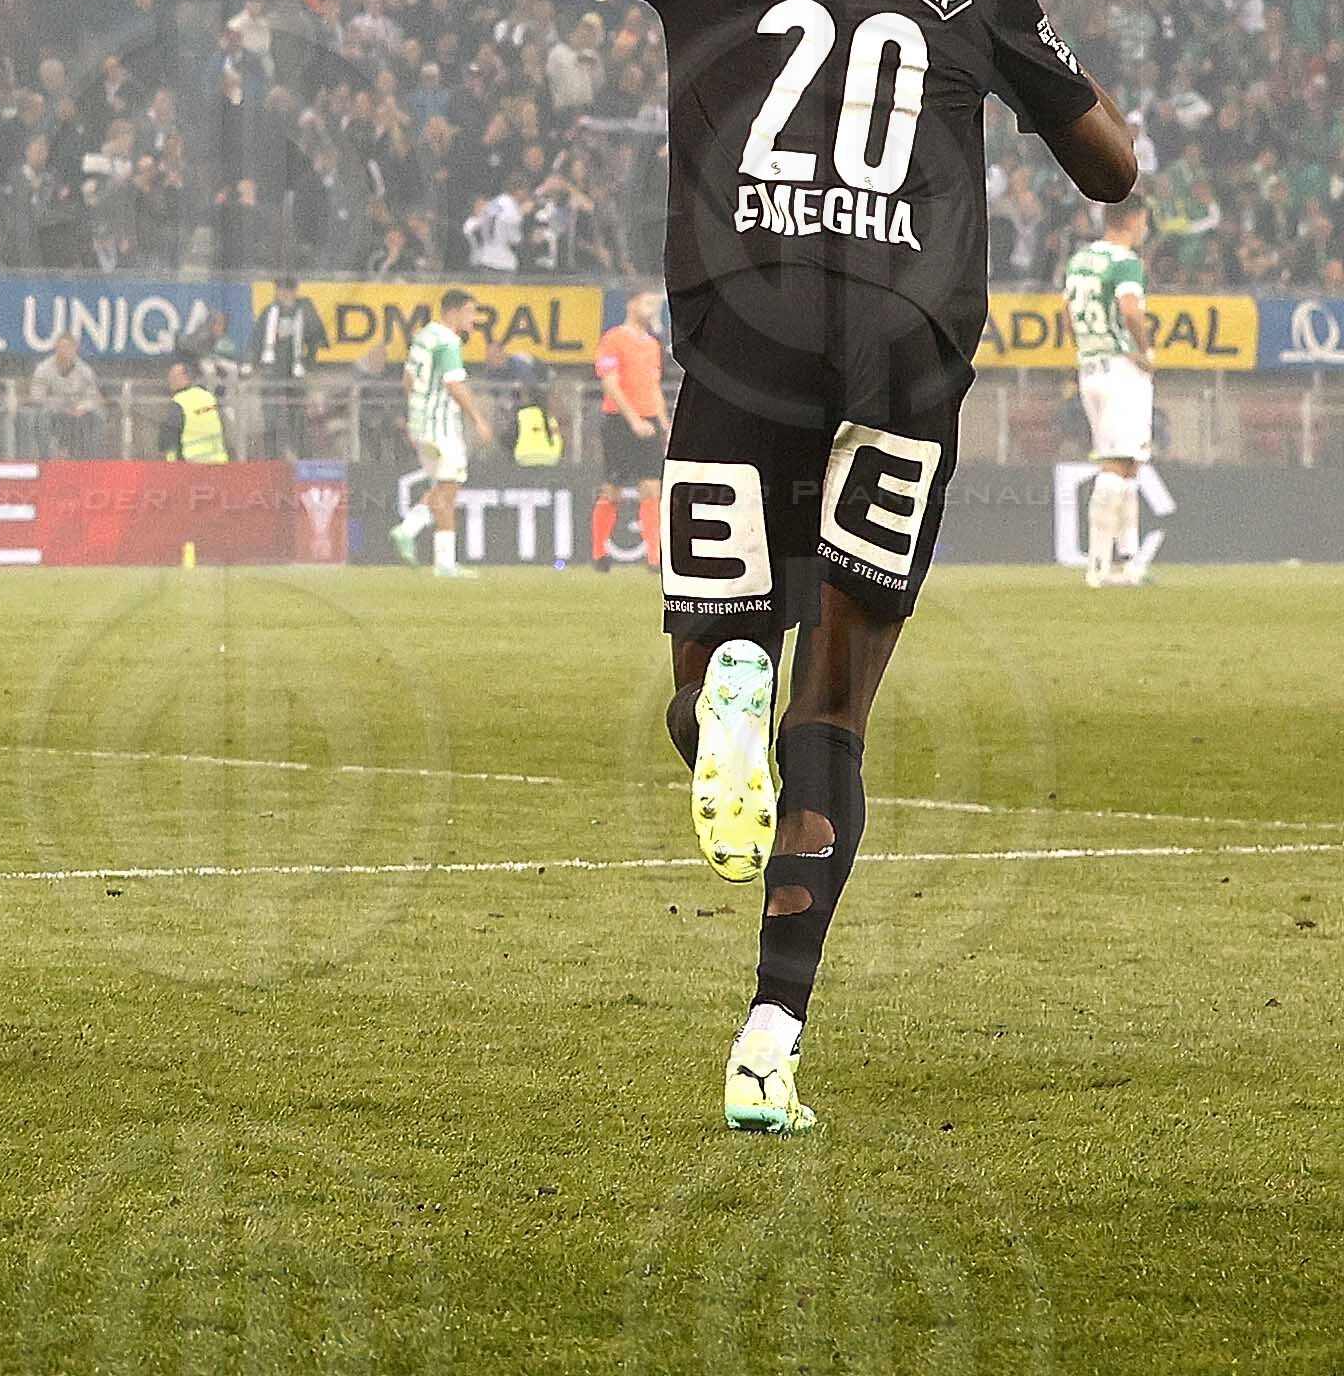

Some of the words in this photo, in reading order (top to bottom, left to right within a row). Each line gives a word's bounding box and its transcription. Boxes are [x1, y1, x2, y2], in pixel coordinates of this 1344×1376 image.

[734, 182, 922, 252] EMEGHA
[669, 482, 747, 580] E
[834, 445, 923, 556] E
[697, 600, 772, 615] STEIERMARK
